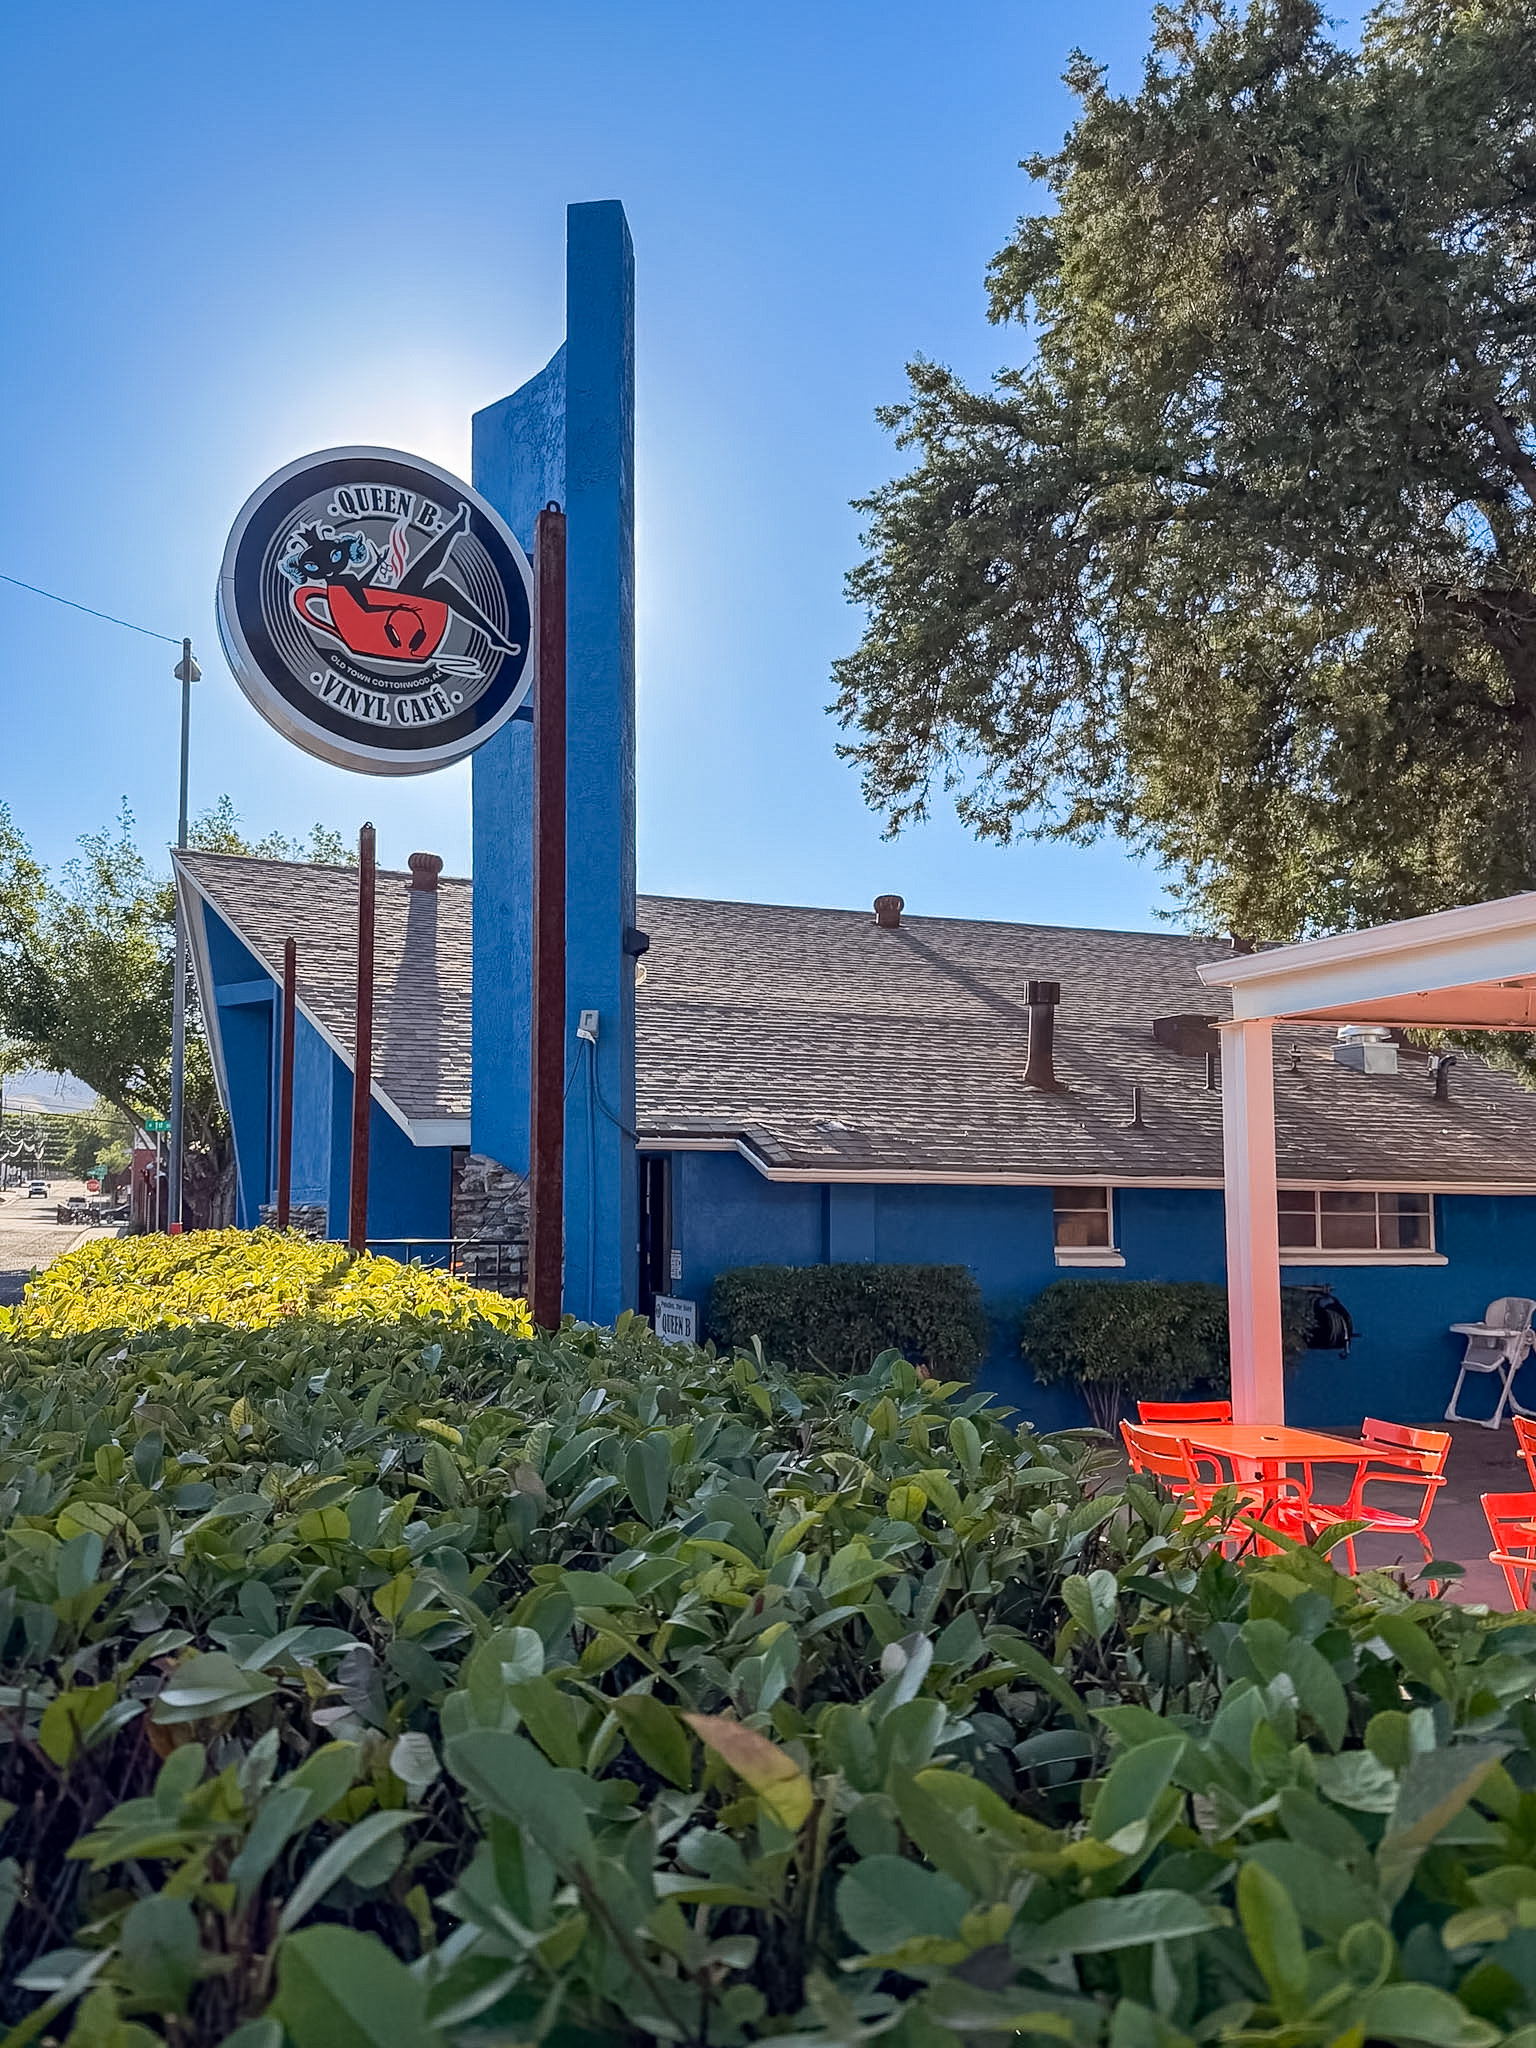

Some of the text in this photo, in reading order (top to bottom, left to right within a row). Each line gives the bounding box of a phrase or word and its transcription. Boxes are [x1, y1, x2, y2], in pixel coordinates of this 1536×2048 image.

[338, 487, 413, 518] QUEEN
[330, 654, 346, 669] OLD
[346, 666, 371, 683] TOWN
[432, 670, 442, 681] AZ
[322, 674, 451, 724] VINYL CAFÉ
[662, 1314, 691, 1336] QUEEN B
